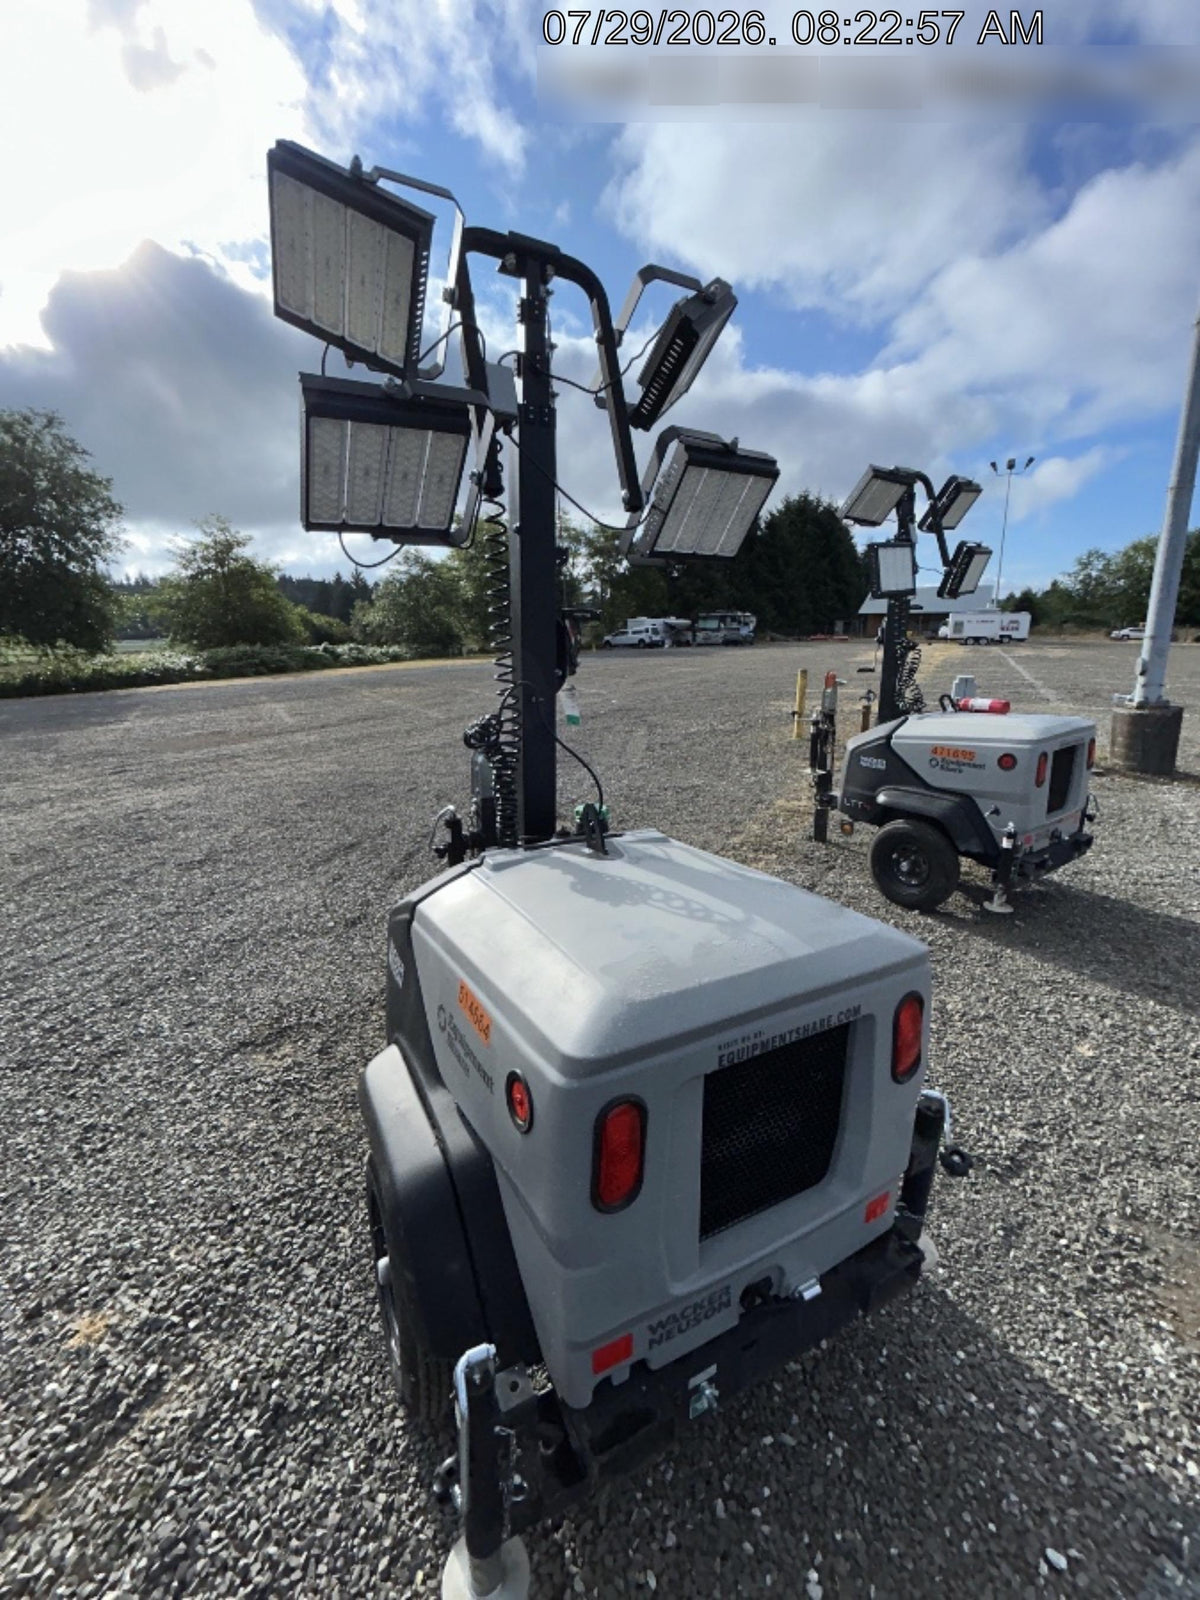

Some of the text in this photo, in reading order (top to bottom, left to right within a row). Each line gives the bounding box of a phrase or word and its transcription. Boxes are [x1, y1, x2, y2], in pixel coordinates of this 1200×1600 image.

[718, 1004, 861, 1069] EQUIPMENTSHARE.COM
[646, 1284, 731, 1336] WACKER
[648, 1299, 732, 1350] NEUSON
